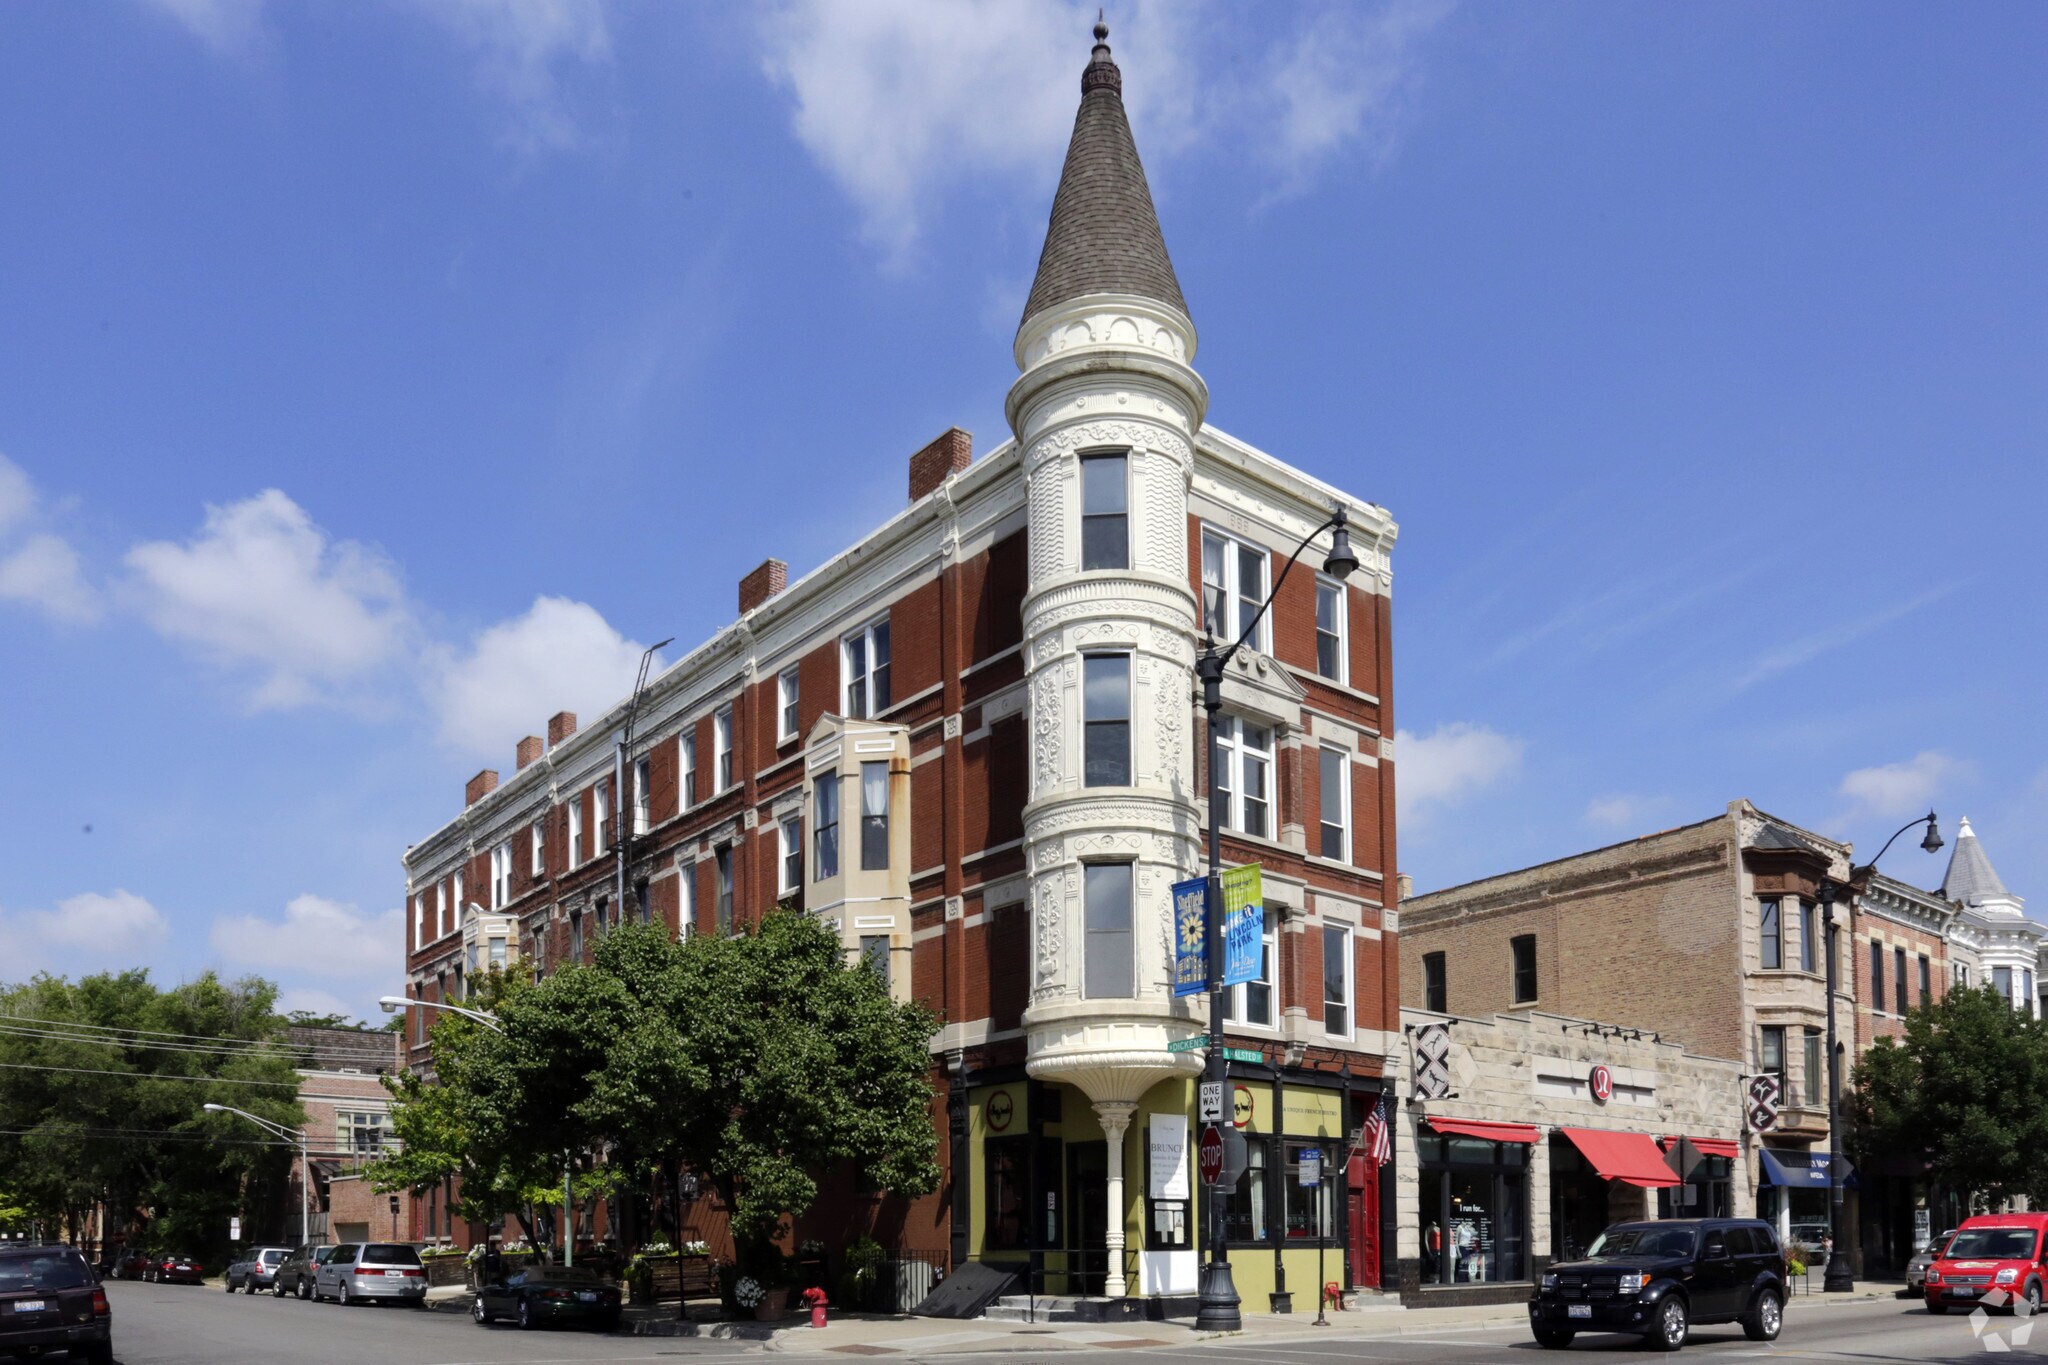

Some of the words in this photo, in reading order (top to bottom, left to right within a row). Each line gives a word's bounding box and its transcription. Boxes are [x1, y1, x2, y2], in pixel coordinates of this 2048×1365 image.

[1244, 905, 1252, 918] it
[1229, 914, 1263, 940] LINCOLN
[1231, 932, 1253, 951] PARK
[1173, 1039, 1204, 1051] DICKENS
[1229, 1049, 1257, 1062] HALSTED
[1203, 1085, 1220, 1096] ONE
[1202, 1096, 1220, 1106] WAY
[1151, 1143, 1185, 1153] BRUNCH
[1201, 1145, 1222, 1168] STOP
[1459, 1203, 1462, 1212] I
